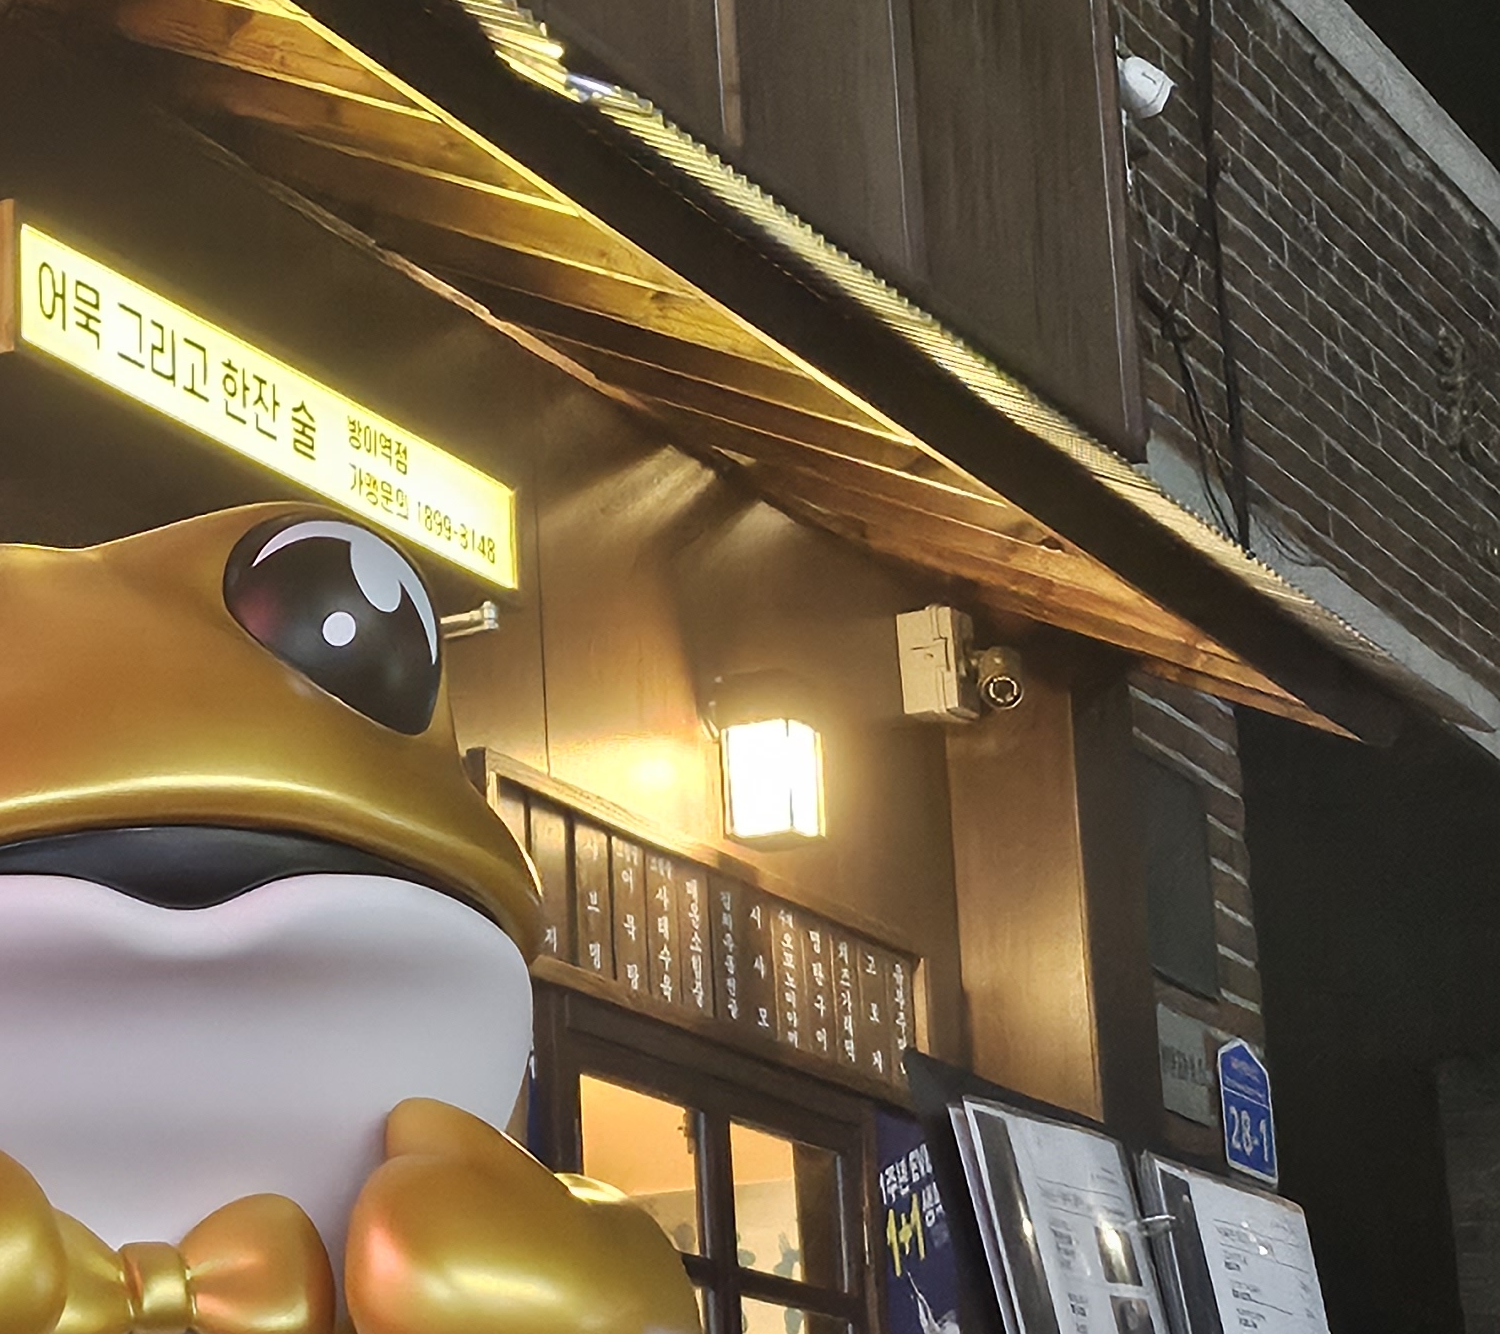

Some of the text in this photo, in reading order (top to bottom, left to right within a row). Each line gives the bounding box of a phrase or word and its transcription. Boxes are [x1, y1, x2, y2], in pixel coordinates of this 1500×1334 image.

[38, 262, 316, 460] 어묵 그리고 한잔 술
[347, 415, 407, 475] 방이역점
[349, 463, 496, 565] 가맹문의 1899-3148
[1229, 1105, 1270, 1163] 28-1
[886, 1192, 927, 1278] 1+1
